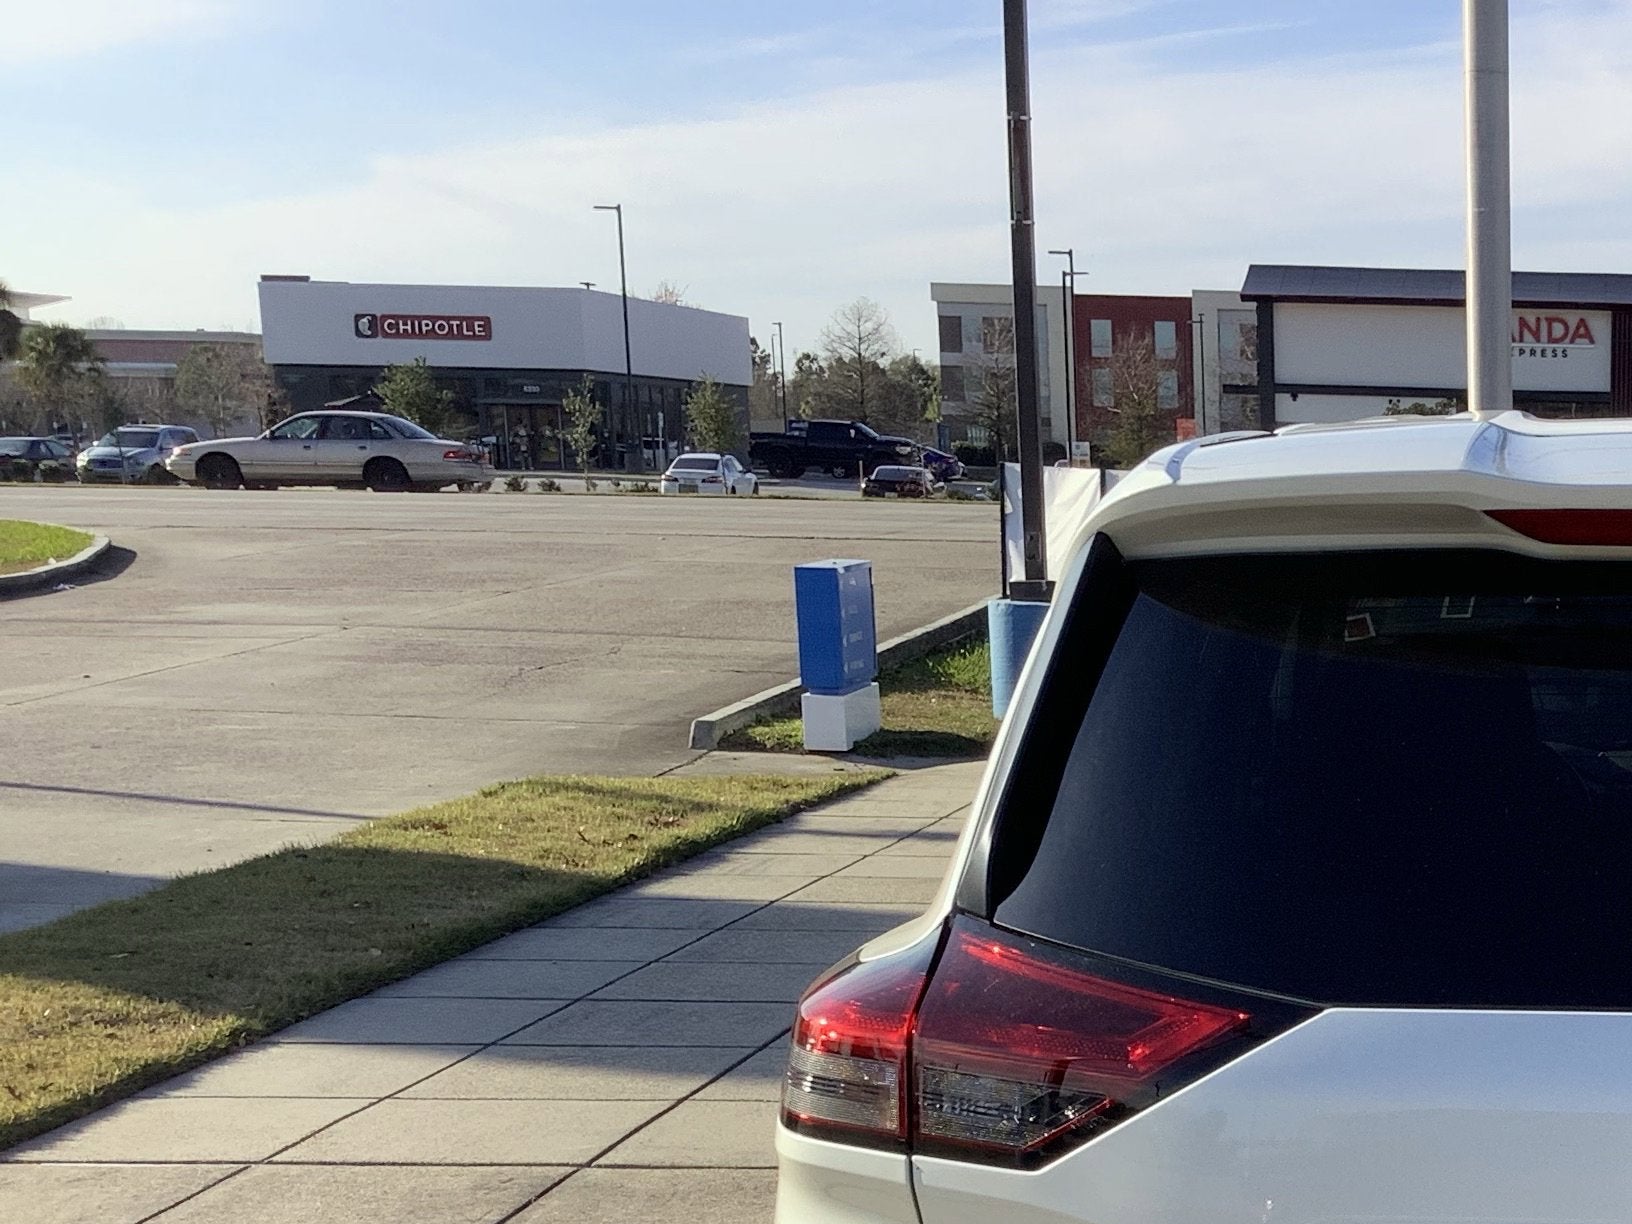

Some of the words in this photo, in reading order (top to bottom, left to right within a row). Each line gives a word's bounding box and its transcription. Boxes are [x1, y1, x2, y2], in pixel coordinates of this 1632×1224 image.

[383, 319, 486, 336] CHIPOTLE
[1512, 316, 1595, 344] NDA
[1511, 348, 1568, 358] PRESS
